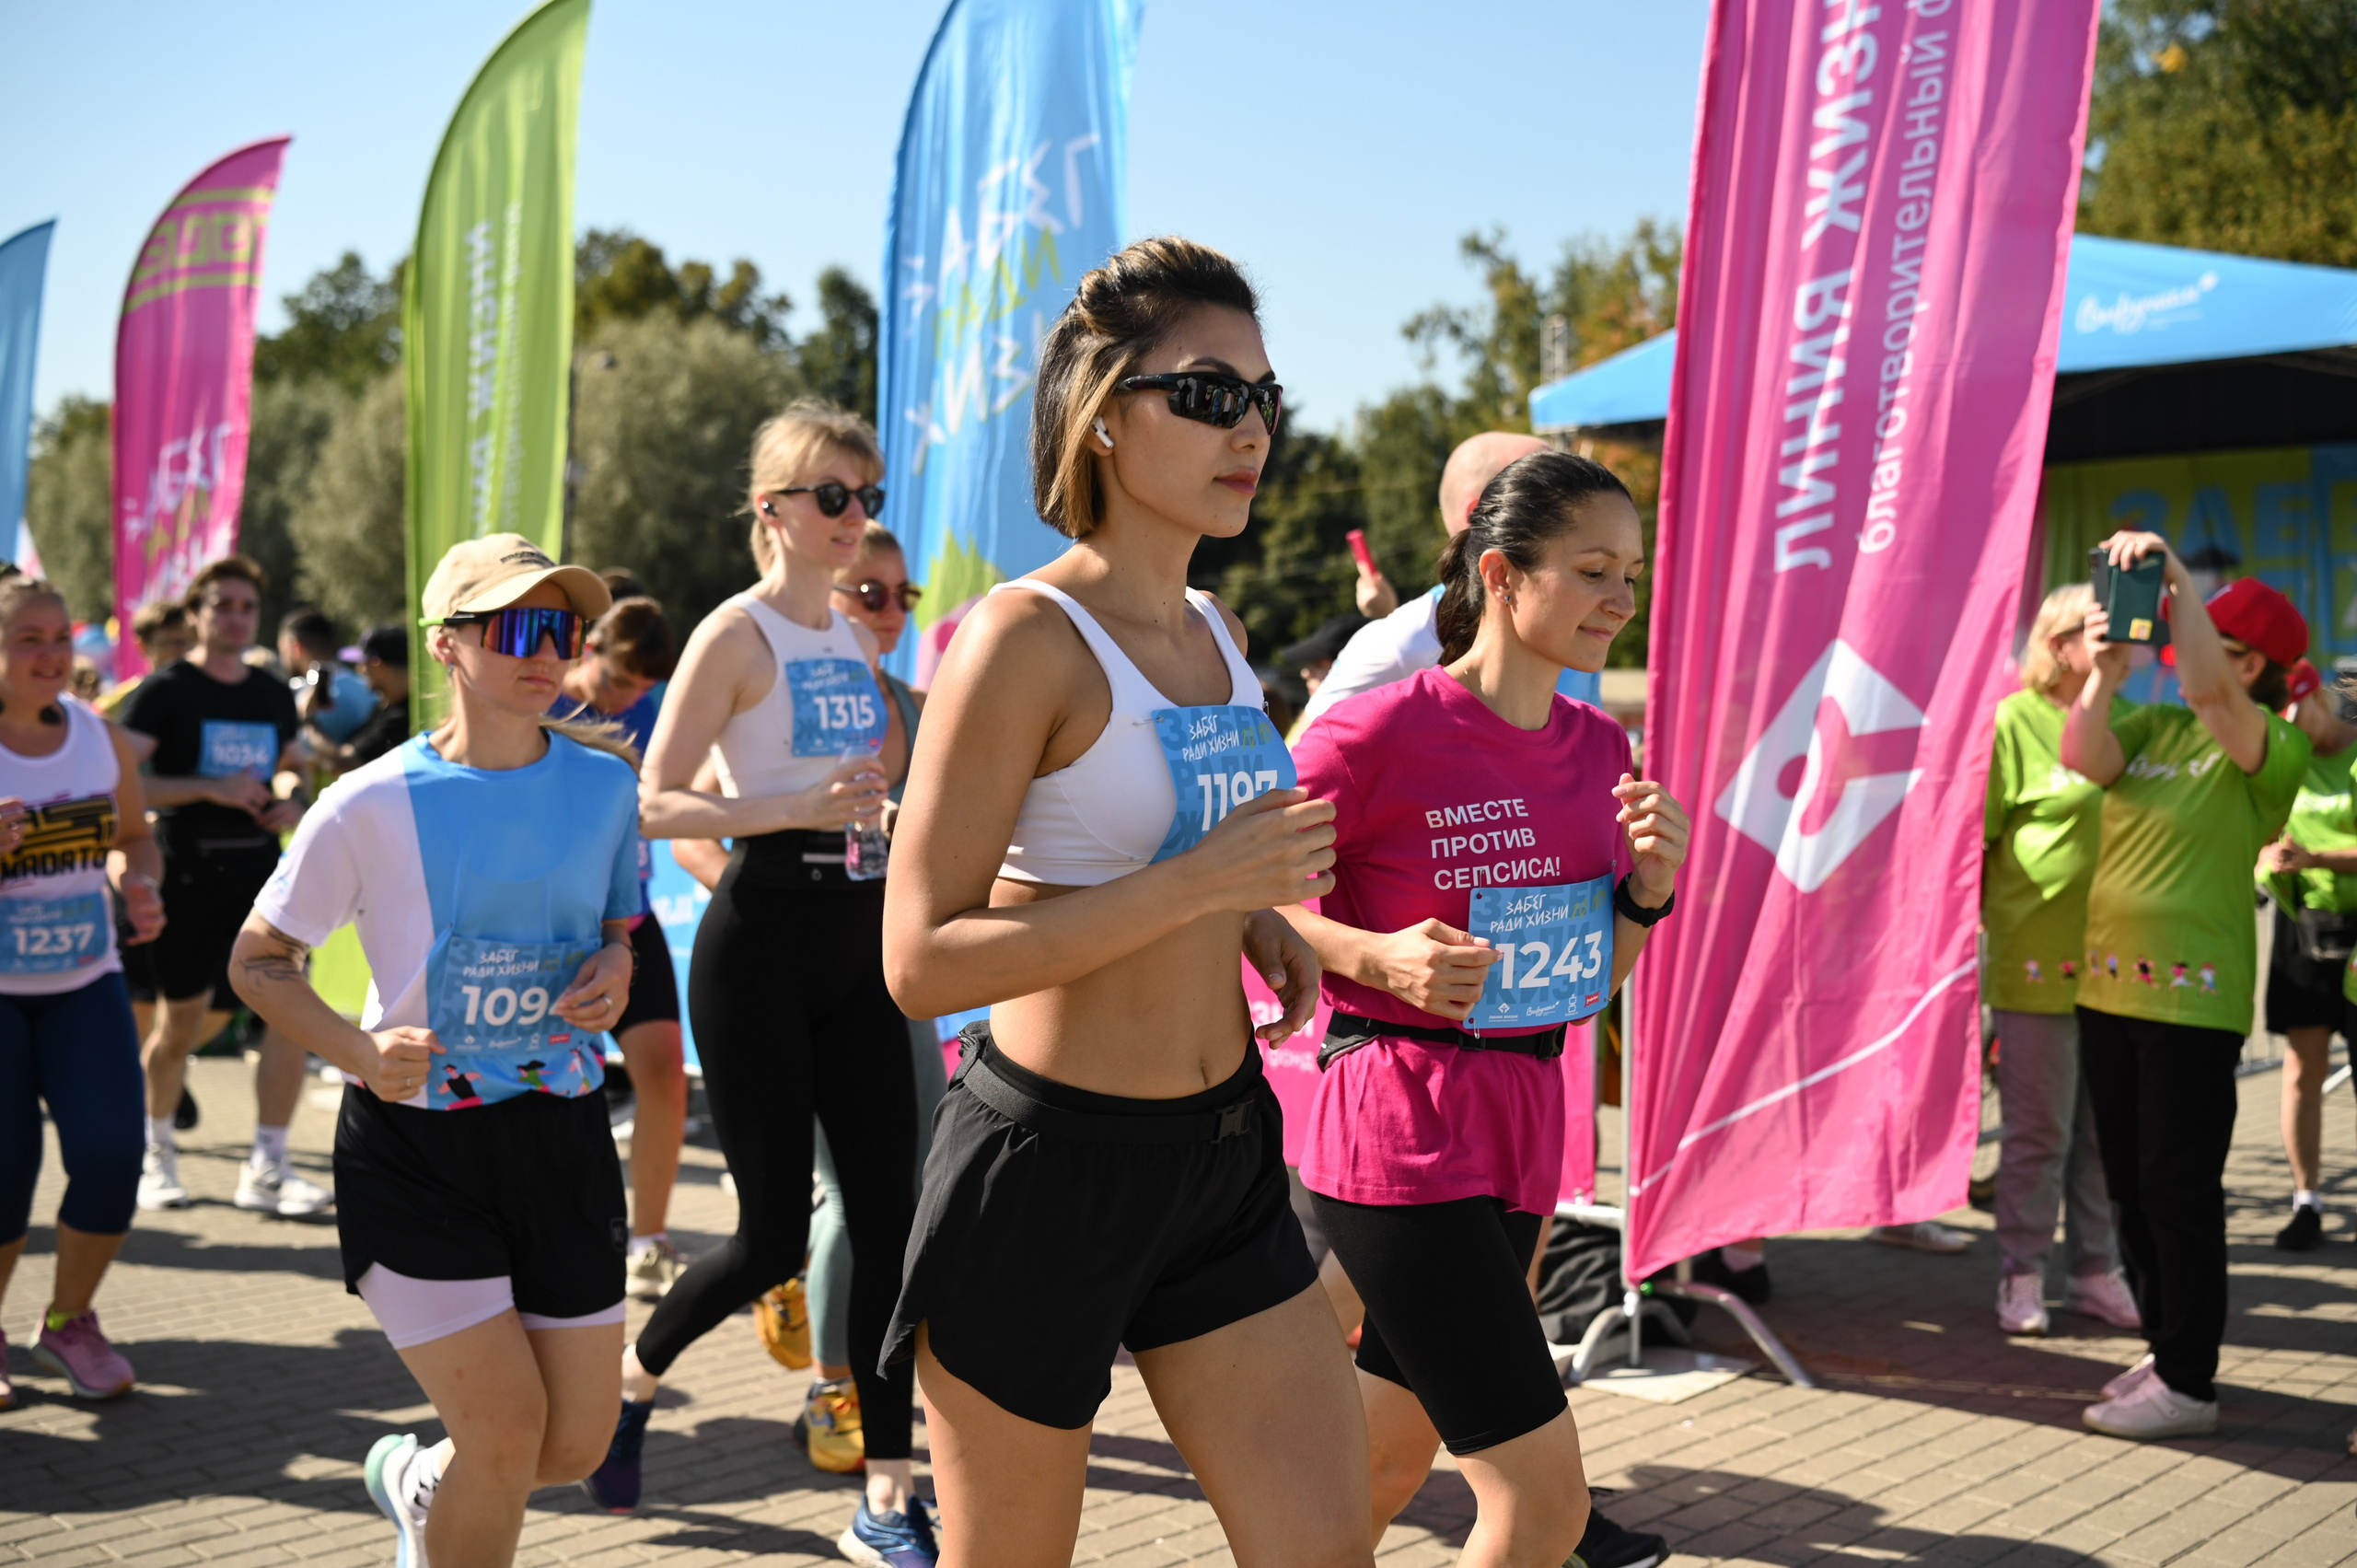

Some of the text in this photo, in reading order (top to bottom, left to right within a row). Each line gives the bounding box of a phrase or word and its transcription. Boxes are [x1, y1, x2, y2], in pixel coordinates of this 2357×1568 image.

[1855, 29, 1948, 554] благотворительный
[1774, 266, 1853, 574] ЛИНИЯ
[813, 694, 876, 730] 1315
[1189, 714, 1218, 740] ЗАБЕГ
[1182, 744, 1207, 762] РАДИ
[1209, 729, 1240, 756] ЖИЗНИ
[1425, 798, 1529, 829] ВМЕСТЕ
[1431, 828, 1537, 859] ПРОТИВ
[1434, 856, 1561, 890] СЕПСИСА!
[1490, 914, 1522, 934] РАДИ
[1526, 904, 1569, 928] ЖИЗНИ
[1505, 894, 1547, 915] ЗАБЕГ
[13, 923, 96, 956] 1237
[463, 965, 494, 979] РАДИ
[480, 949, 519, 965] ЗАБЕГ
[1495, 930, 1603, 989] 1243
